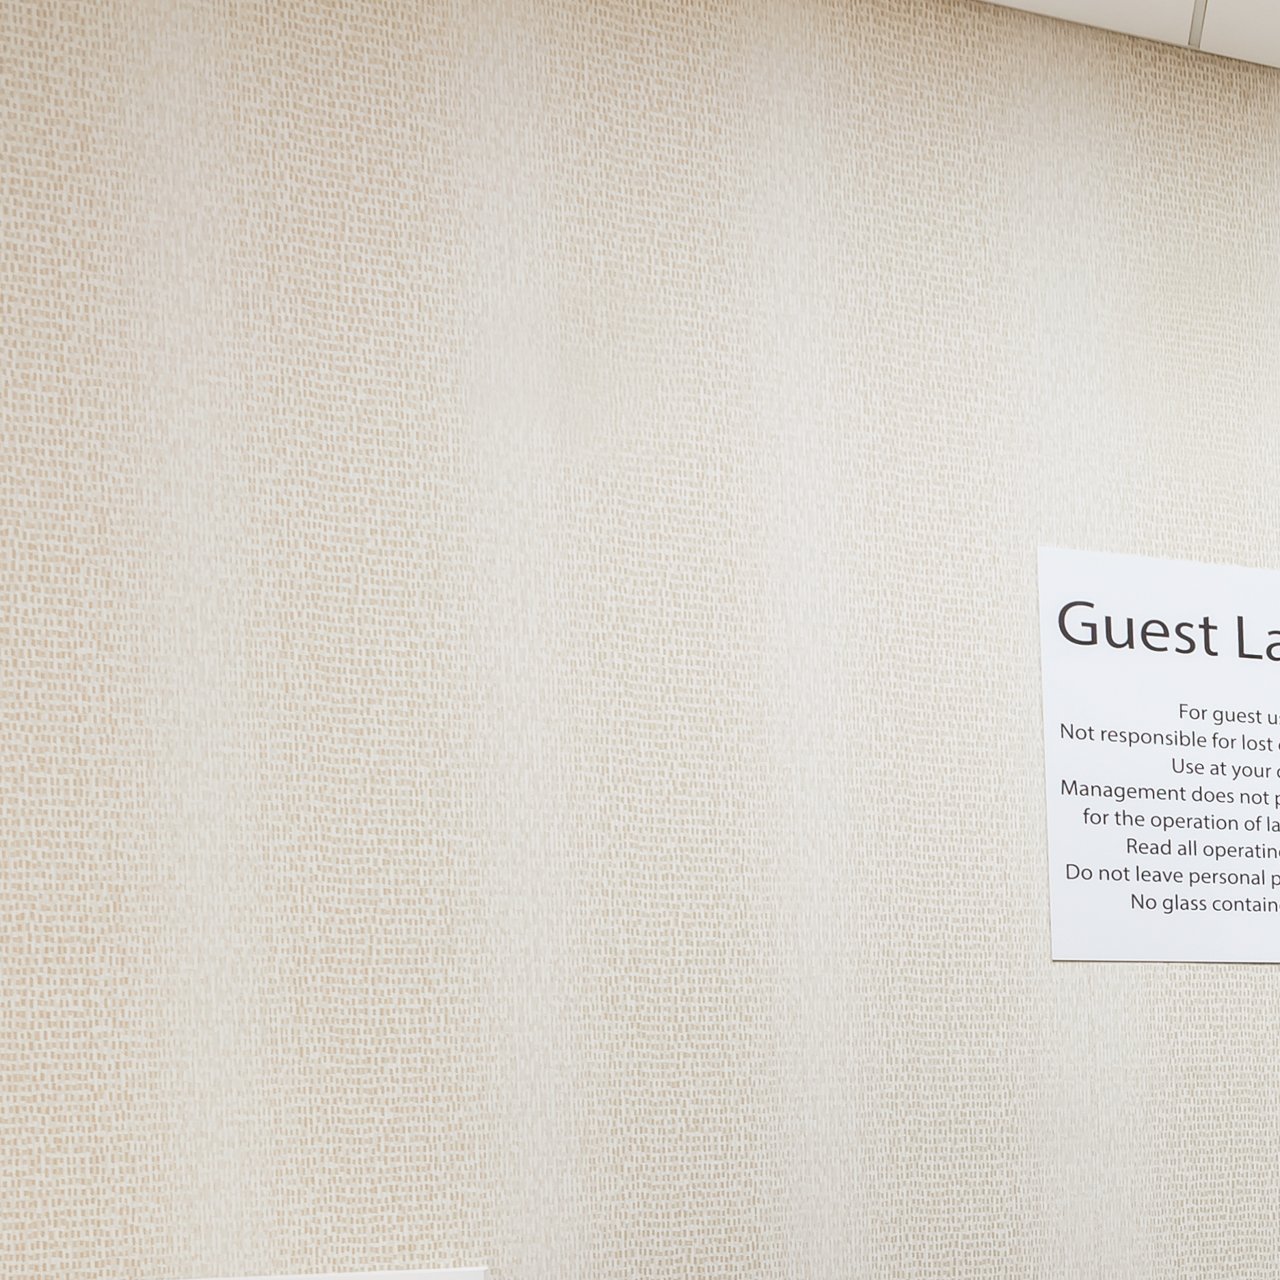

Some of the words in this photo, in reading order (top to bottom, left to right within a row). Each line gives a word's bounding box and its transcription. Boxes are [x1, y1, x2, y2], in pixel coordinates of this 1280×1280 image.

[1057, 600, 1219, 657] Guest
[1179, 702, 1209, 721] For
[1212, 709, 1263, 726] guest
[1060, 722, 1096, 742] Not
[1100, 729, 1208, 749] responsible
[1211, 731, 1238, 750] for
[1241, 733, 1274, 753] lost
[1171, 757, 1205, 776] Use
[1209, 761, 1228, 777] at
[1231, 764, 1273, 782] your
[1060, 778, 1187, 803] Management
[1190, 785, 1235, 804] does
[1239, 790, 1270, 806] not
[1082, 806, 1110, 826] for
[1113, 808, 1146, 828] the
[1150, 813, 1239, 833] operation
[1243, 814, 1263, 832] of
[1126, 837, 1172, 856] Read
[1176, 839, 1198, 857] all
[1065, 863, 1094, 881] Do
[1098, 866, 1131, 883] not
[1135, 864, 1184, 884] leave
[1188, 868, 1266, 888] personal
[1130, 893, 1158, 911] No
[1161, 893, 1208, 915] glass
